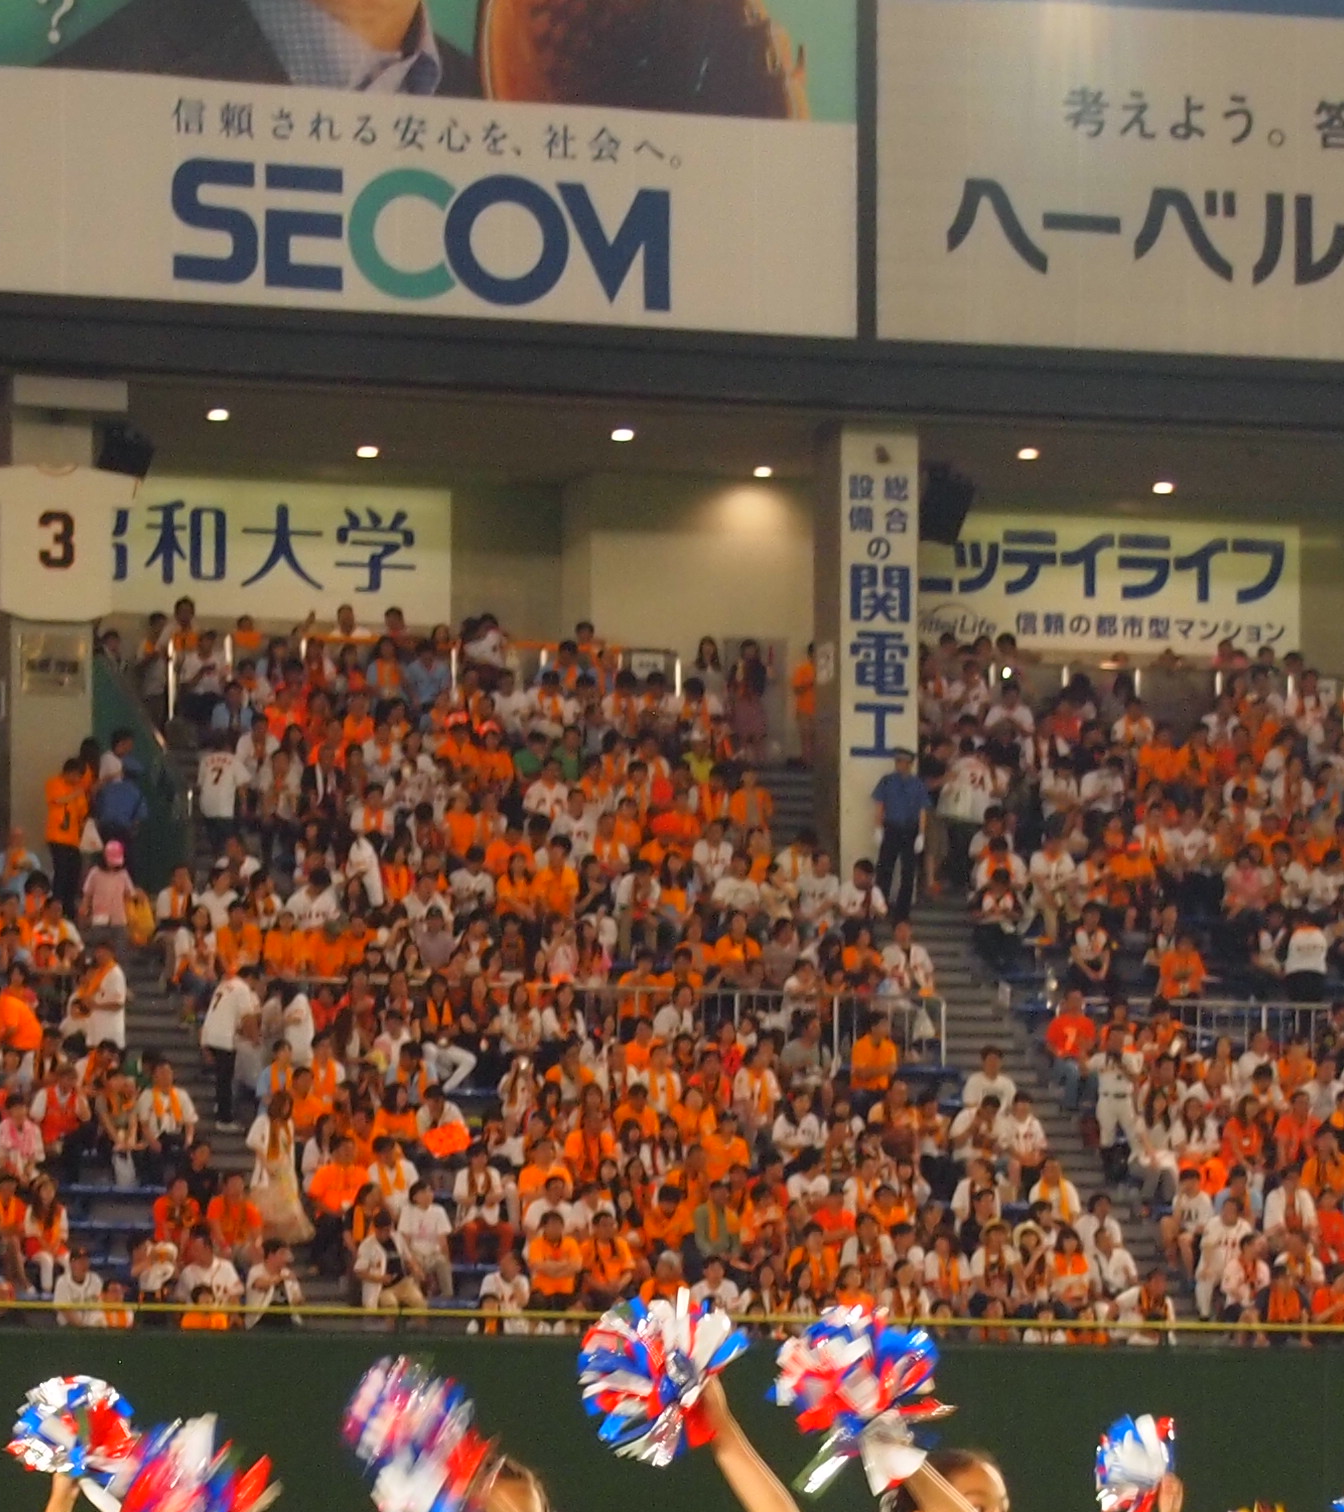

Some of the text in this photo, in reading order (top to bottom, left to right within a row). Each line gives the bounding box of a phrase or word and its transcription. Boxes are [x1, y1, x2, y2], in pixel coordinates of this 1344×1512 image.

[171, 97, 683, 170] 信頼される安心を、社会へ。
[171, 157, 672, 312] SECOM
[38, 510, 76, 569] 3
[112, 500, 417, 593] 和大学
